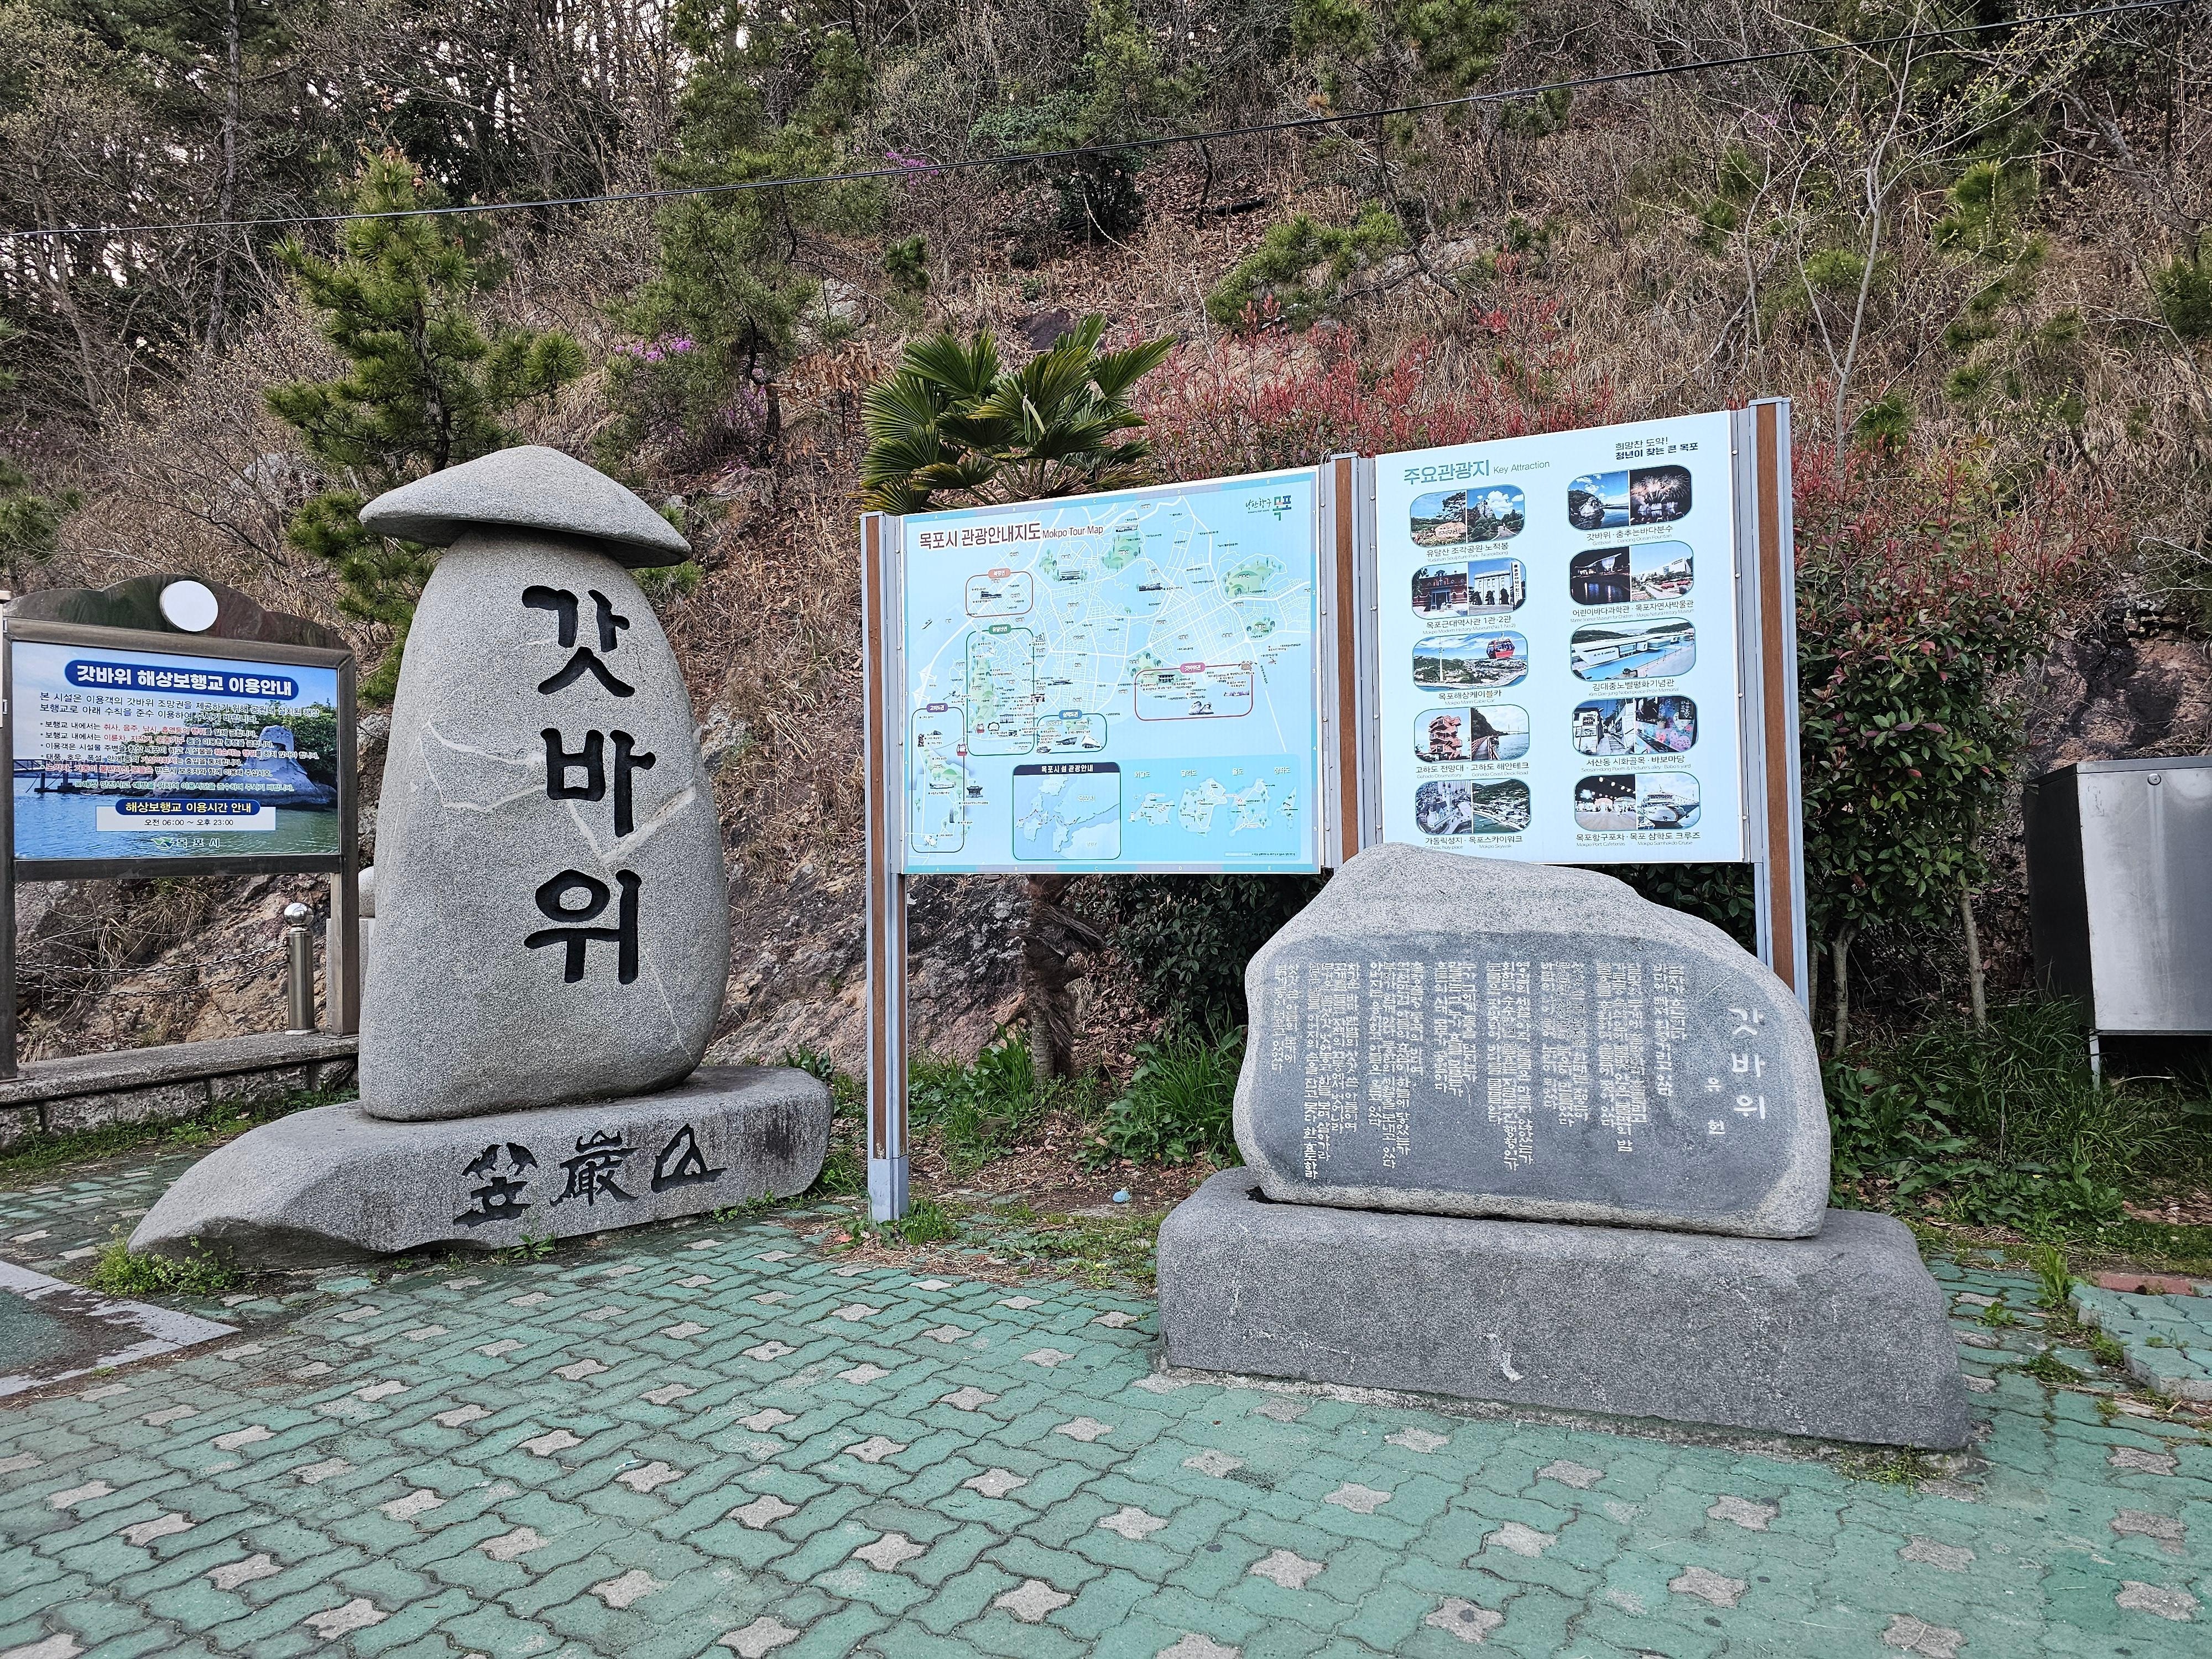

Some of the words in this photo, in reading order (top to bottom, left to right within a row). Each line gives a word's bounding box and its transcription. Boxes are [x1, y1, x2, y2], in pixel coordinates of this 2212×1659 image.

[1615, 440, 1643, 451] 희망찬
[1646, 437, 1668, 447] 도약!
[1615, 449, 1643, 460] 청년이
[1646, 446, 1664, 456] 찾는
[1667, 445, 1677, 453] 큰
[1680, 442, 1698, 451] 목포
[1404, 460, 1489, 485] 주요관광지
[1494, 466, 1508, 474] Key
[1511, 461, 1550, 472] Attraction
[920, 530, 957, 550] 목포시
[962, 523, 1040, 546] 관광안내지도
[1042, 529, 1067, 539] Mokpo
[1069, 527, 1085, 536] Tour
[1087, 526, 1103, 535] Map
[1587, 531, 1610, 541] 갓바위
[1616, 525, 1673, 538] 춤추는바다분수
[1573, 606, 1630, 617] 어린이바다과학관
[1636, 599, 1693, 612] 목포자연사박물관
[1427, 618, 1480, 629] 목포근대역사관
[77, 665, 131, 685] 갓바위
[138, 670, 223, 691] 해상보행교
[229, 677, 291, 696] 이용안내
[1592, 679, 1674, 691] 김대중노벨평화기념관
[1438, 690, 1501, 700] 목포해상케이블카
[40, 692, 49, 701] 본
[54, 693, 82, 702] 시설은
[86, 695, 123, 705] 이용객의
[127, 697, 154, 707] 갓바위
[158, 700, 192, 709] 조망권을
[196, 702, 229, 712] 제공하기
[232, 704, 248, 713] 위해
[251, 705, 275, 714] 공원내
[278, 707, 301, 717] 설치된
[304, 708, 320, 717] 해상
[40, 704, 79, 713] 보행교로
[83, 706, 101, 715] 아래
[105, 707, 132, 717] 수칙을
[137, 709, 154, 718] 준수
[158, 711, 192, 720] 이용하여
[195, 712, 221, 722] 주시기
[223, 714, 259, 724] 바랍니다.
[157, 737, 185, 745] 운동기구
[80, 743, 101, 752] 시설물
[129, 745, 143, 753] 항상
[169, 747, 183, 755] 하고
[186, 747, 212, 755] 시설물을
[214, 748, 241, 757] 훼손하는
[1587, 759, 1610, 767] 서산동
[1613, 757, 1645, 765] 시화골목
[1651, 755, 1685, 764] 바보마당
[100, 765, 129, 774] 불편하신
[133, 781, 155, 790] 예방을
[521, 585, 657, 985] 갓바위
[126, 802, 182, 813] 해상보행교
[186, 803, 227, 813] 이용시간
[231, 803, 251, 812] 안내
[1426, 837, 1462, 845] 가톨릭성지
[1469, 836, 1522, 844] 목포스카이워크
[1576, 833, 1625, 842] 목포항구포차
[1728, 1007, 1766, 1119] 갓바위
